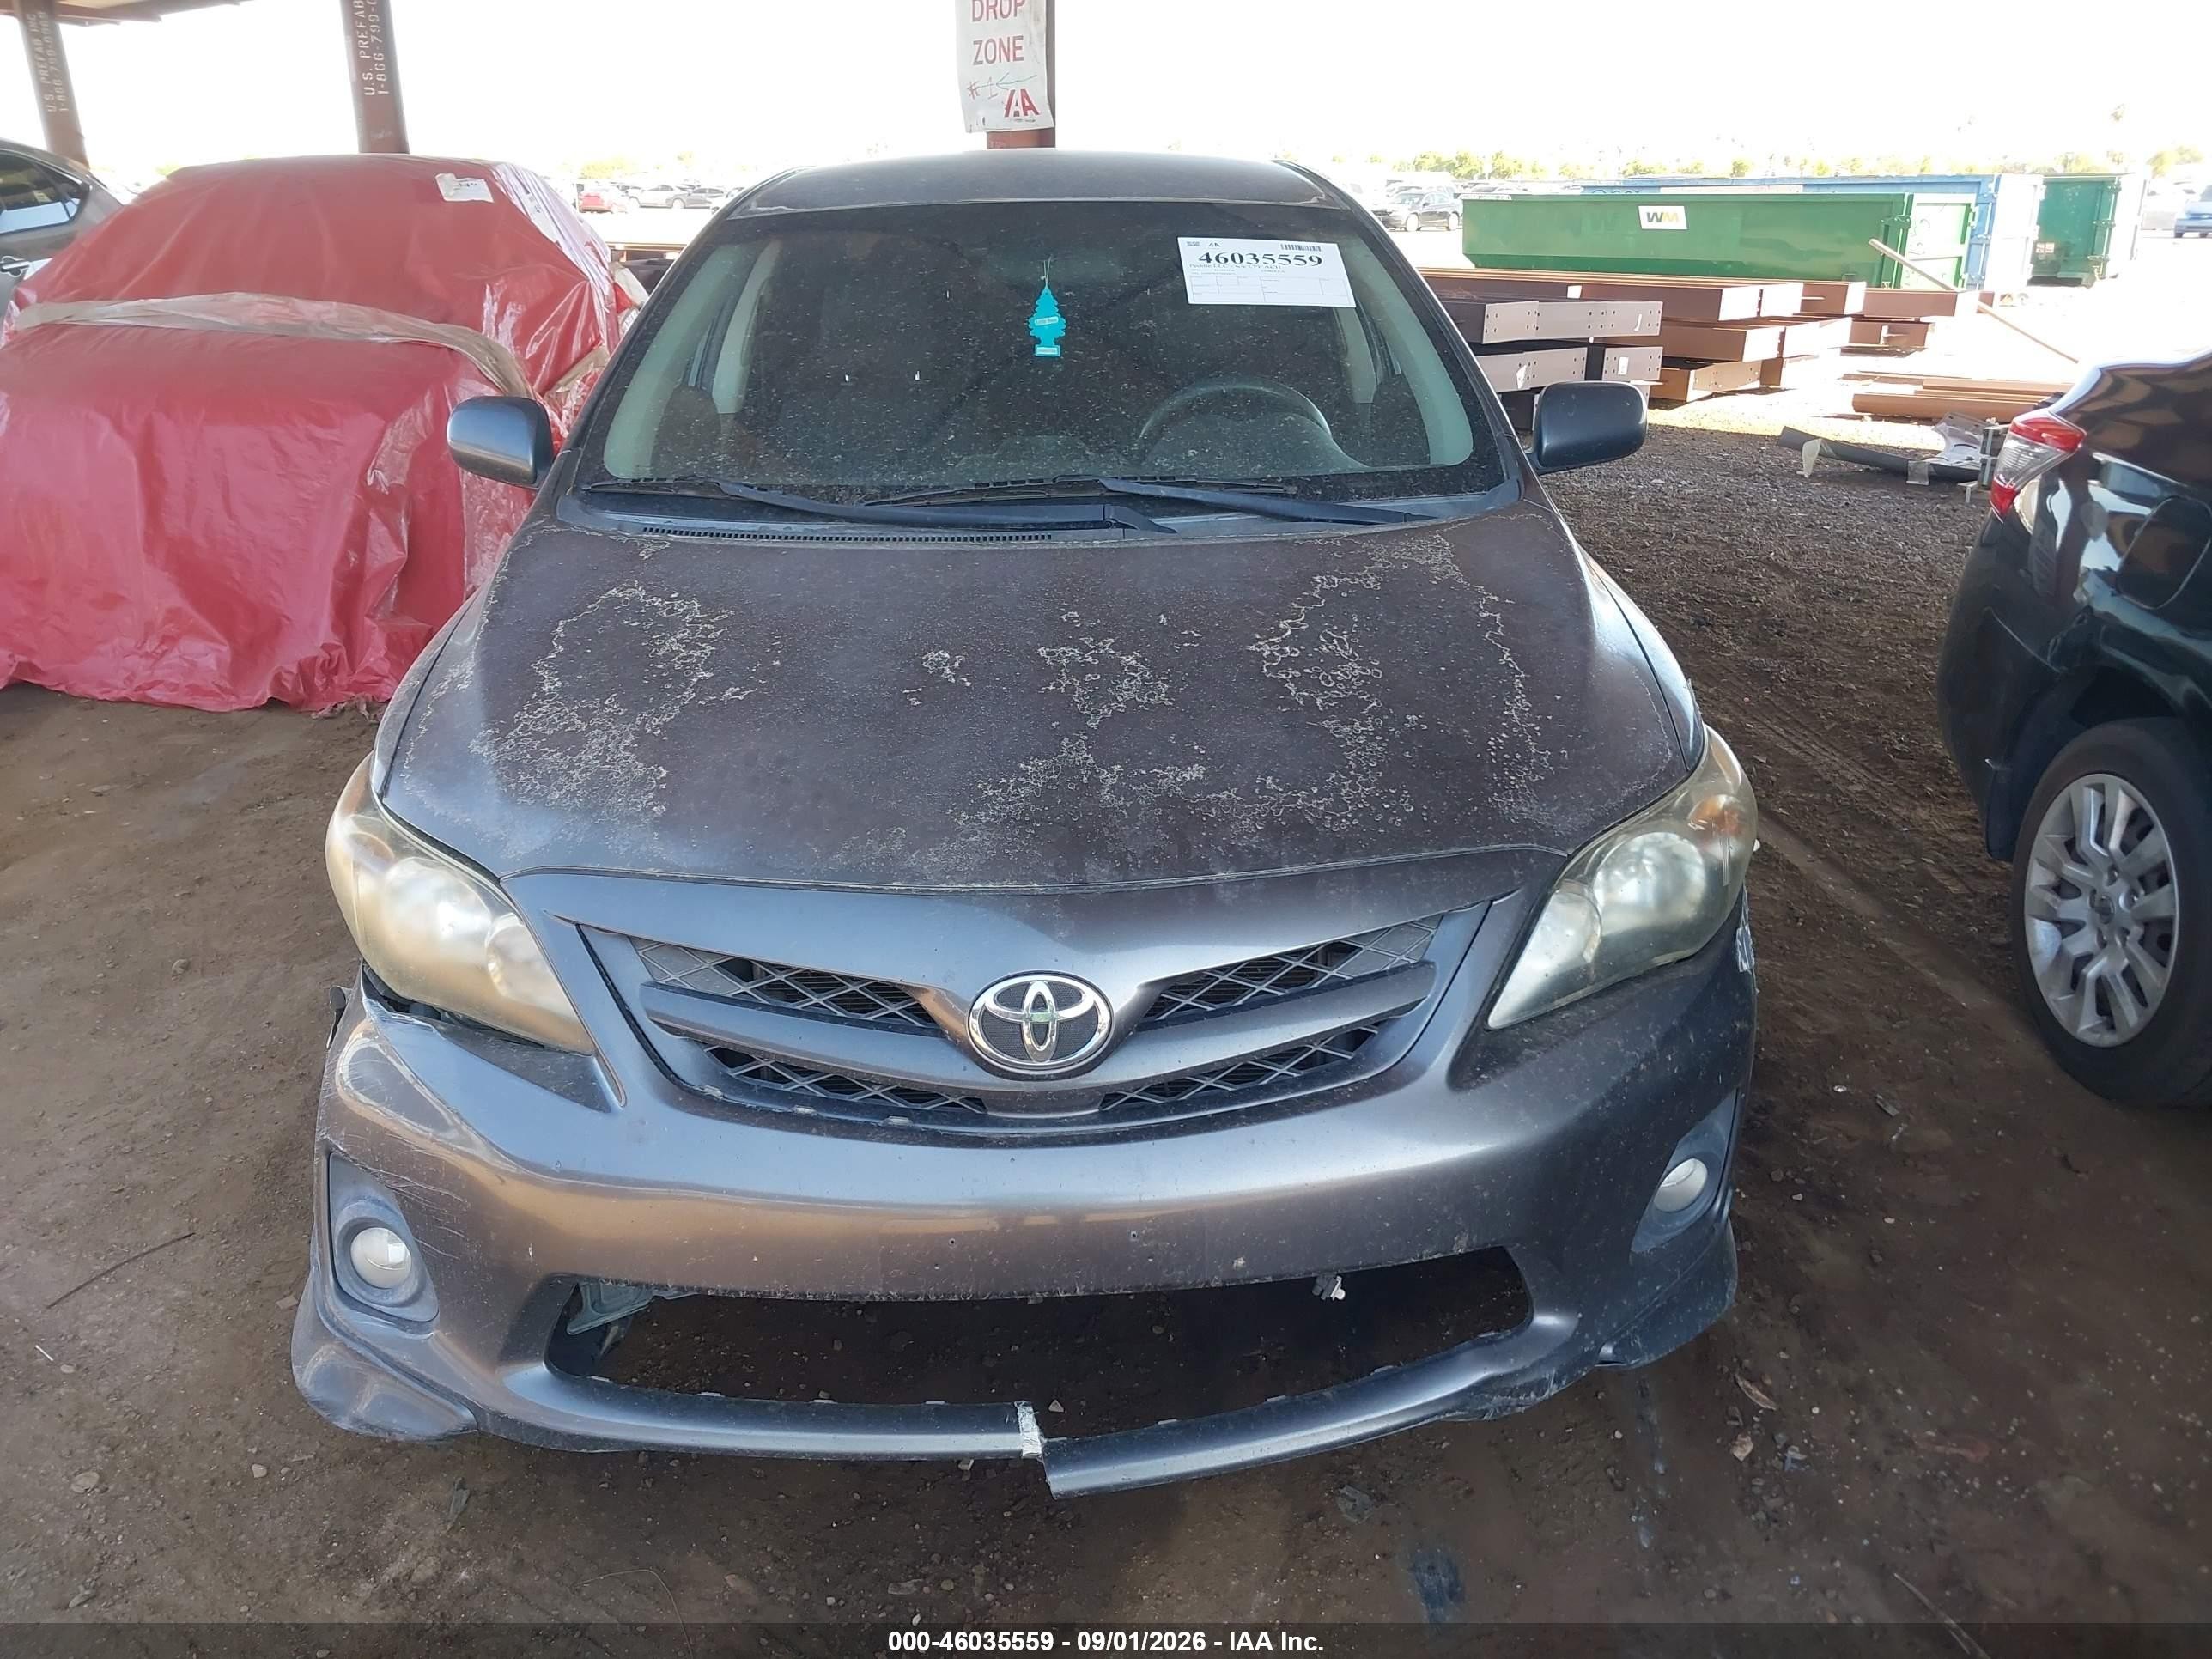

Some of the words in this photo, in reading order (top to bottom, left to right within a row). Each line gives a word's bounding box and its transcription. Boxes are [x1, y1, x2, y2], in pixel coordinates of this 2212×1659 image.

[971, 0, 1025, 22] DROP
[353, 0, 372, 58] PREFAB
[973, 35, 1024, 65] ZONE
[362, 68, 376, 96] U.S.
[1647, 212, 1679, 222] WM
[1199, 252, 1322, 266] 46035559
